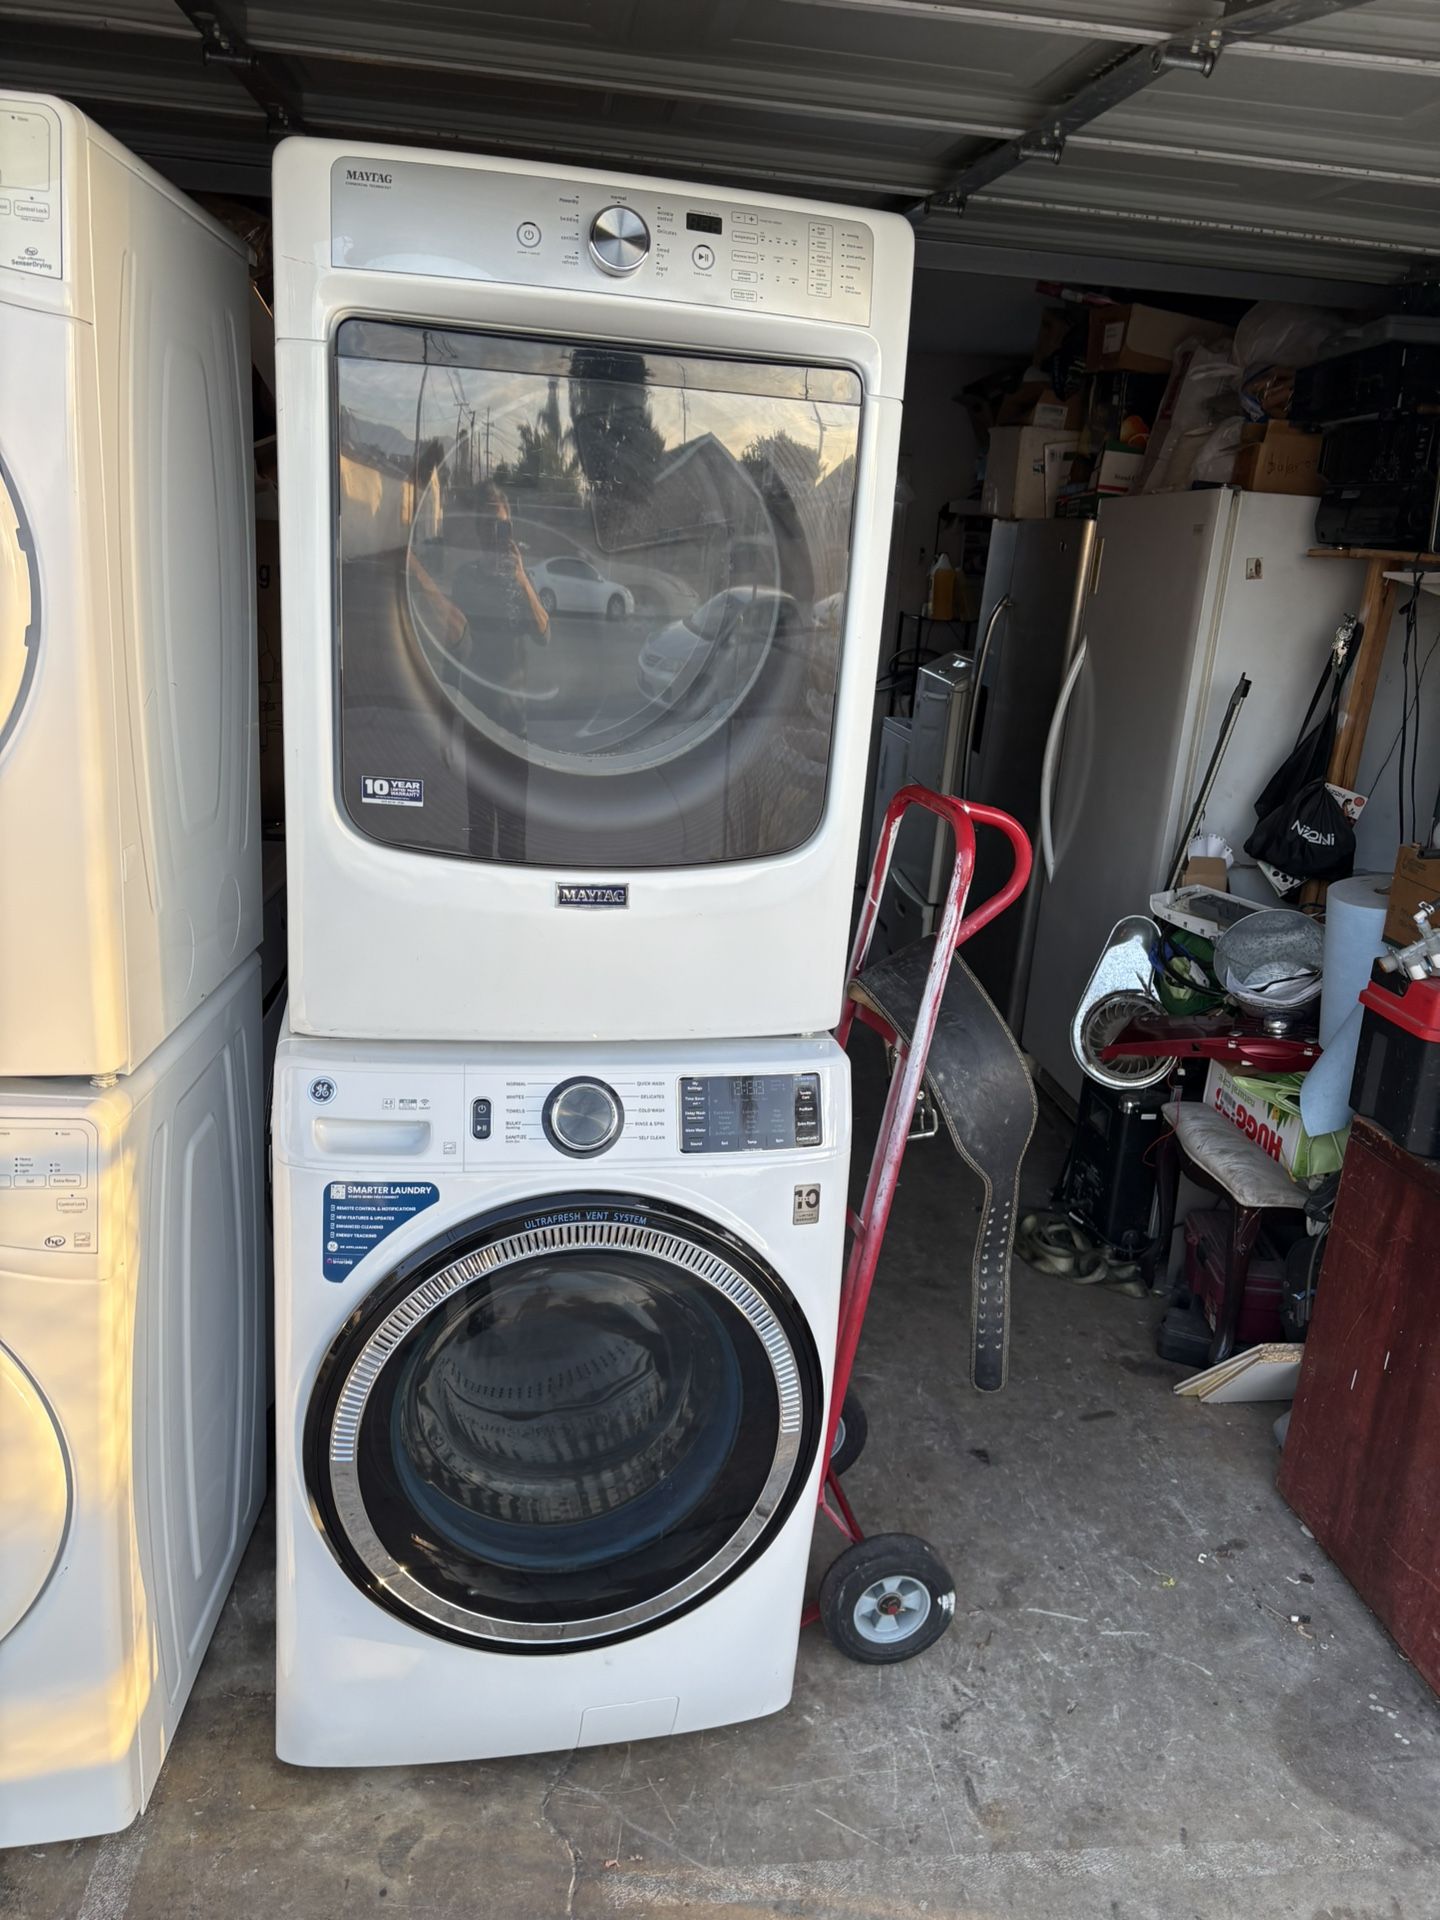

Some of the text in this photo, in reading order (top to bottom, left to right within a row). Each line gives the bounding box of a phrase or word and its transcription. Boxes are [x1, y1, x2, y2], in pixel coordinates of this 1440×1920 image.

[346, 170, 392, 184] MAYTAG
[12, 259, 52, 270] SensorDrying
[365, 779, 420, 795] 10 YEAR
[562, 889, 625, 903] MAYTAG
[347, 1186, 388, 1194] SMARTER
[795, 1189, 820, 1209] 10
[524, 1211, 647, 1229] ULTRAFRESH VENT SYSTEM
